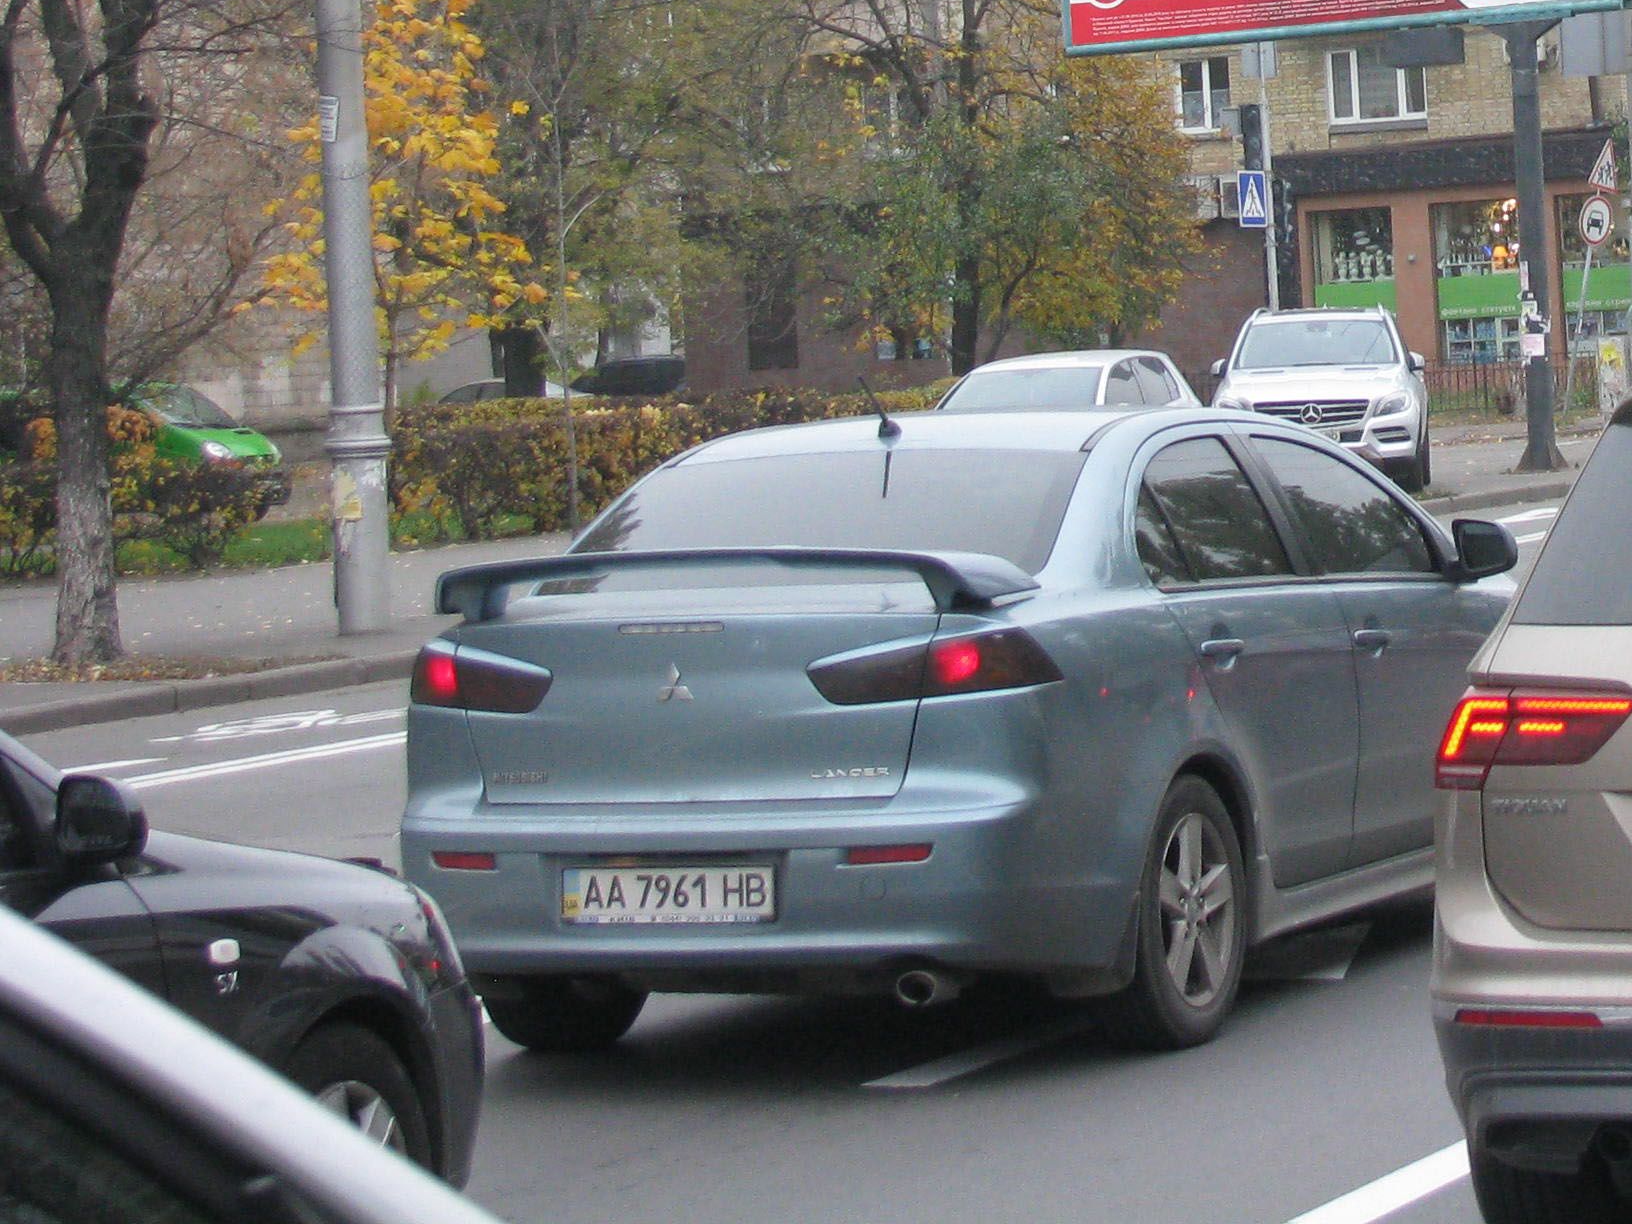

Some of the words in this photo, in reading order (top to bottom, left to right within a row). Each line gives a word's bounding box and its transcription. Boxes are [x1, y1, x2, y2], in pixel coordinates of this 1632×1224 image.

[810, 766, 891, 779] LANCER
[584, 874, 627, 909] AA
[636, 873, 707, 909] 7961
[722, 873, 767, 908] HB
